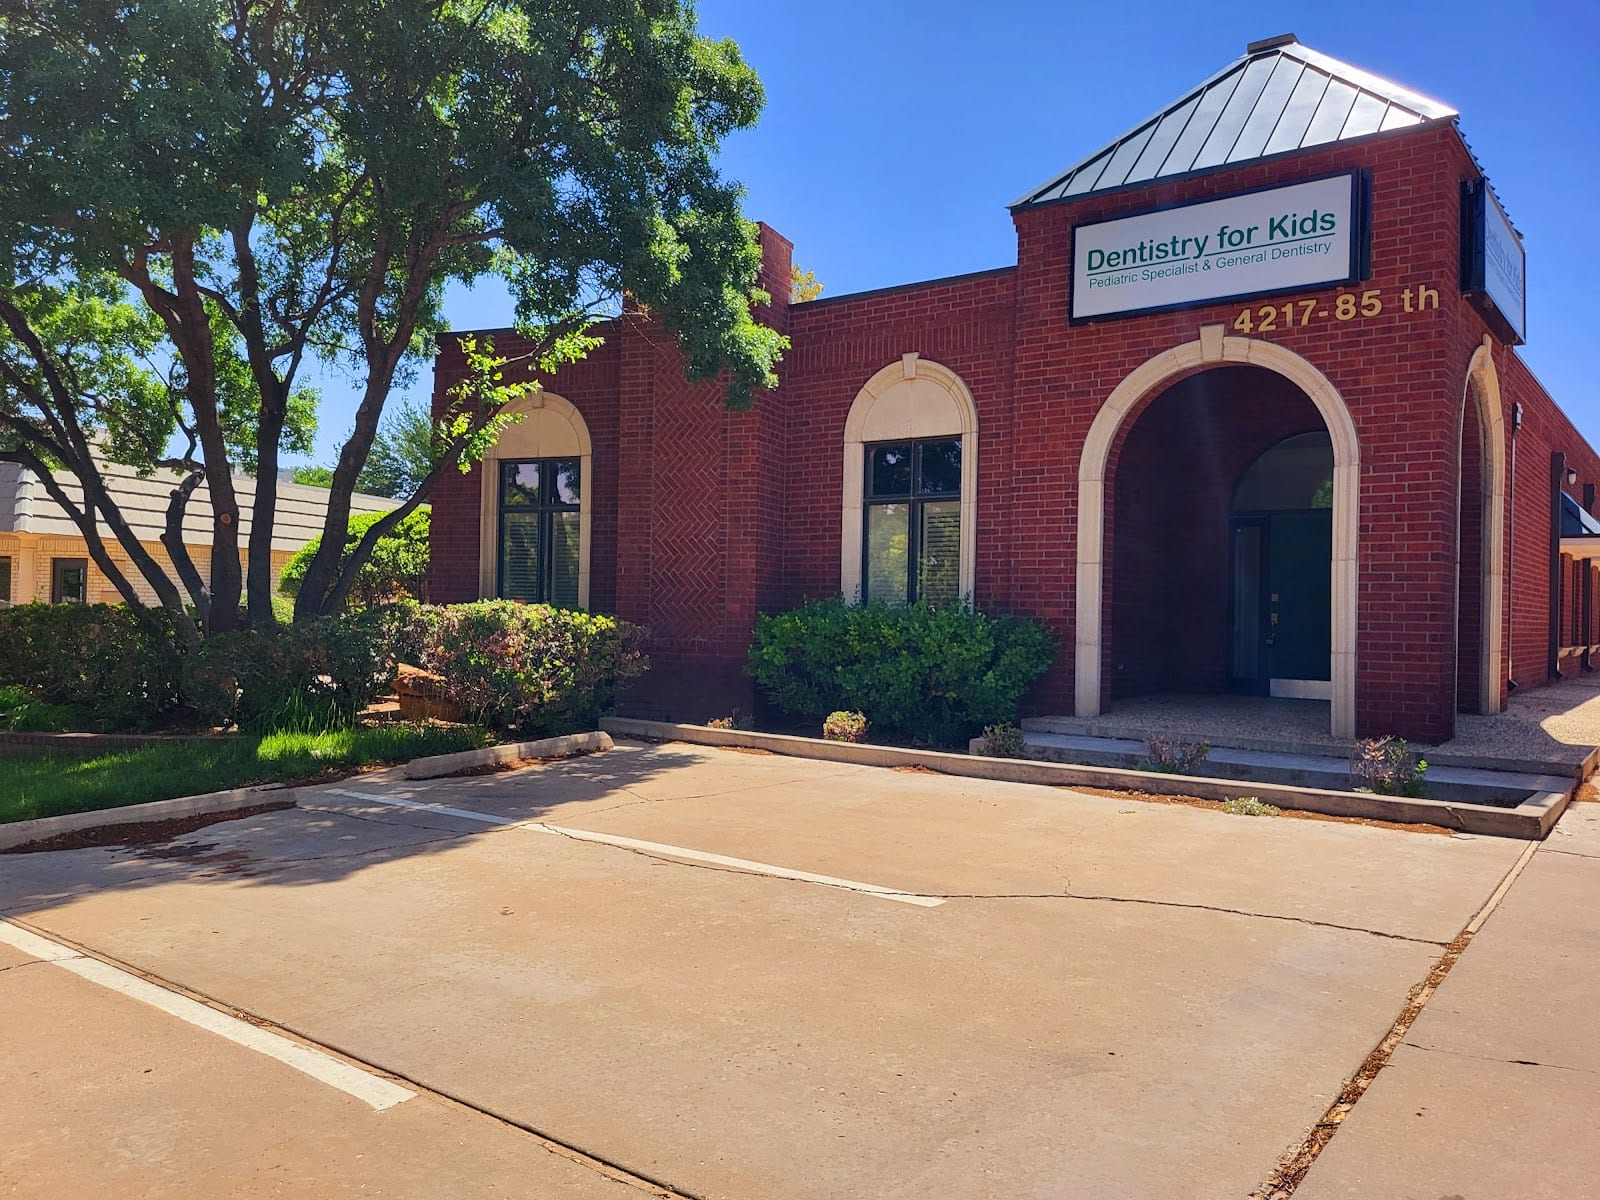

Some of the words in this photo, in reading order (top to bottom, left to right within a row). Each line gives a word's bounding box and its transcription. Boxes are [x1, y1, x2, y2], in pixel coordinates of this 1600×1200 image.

[1087, 234, 1209, 271] Dentistry
[1217, 225, 1259, 249] for
[1269, 209, 1336, 240] Kids
[1089, 273, 1138, 289] Pediatric
[1141, 262, 1199, 282] Specialist
[1202, 259, 1211, 271] &
[1216, 250, 1267, 268] General
[1271, 241, 1332, 260] Dentistry
[1233, 289, 1383, 334] 4217-85
[1401, 285, 1439, 313] th
